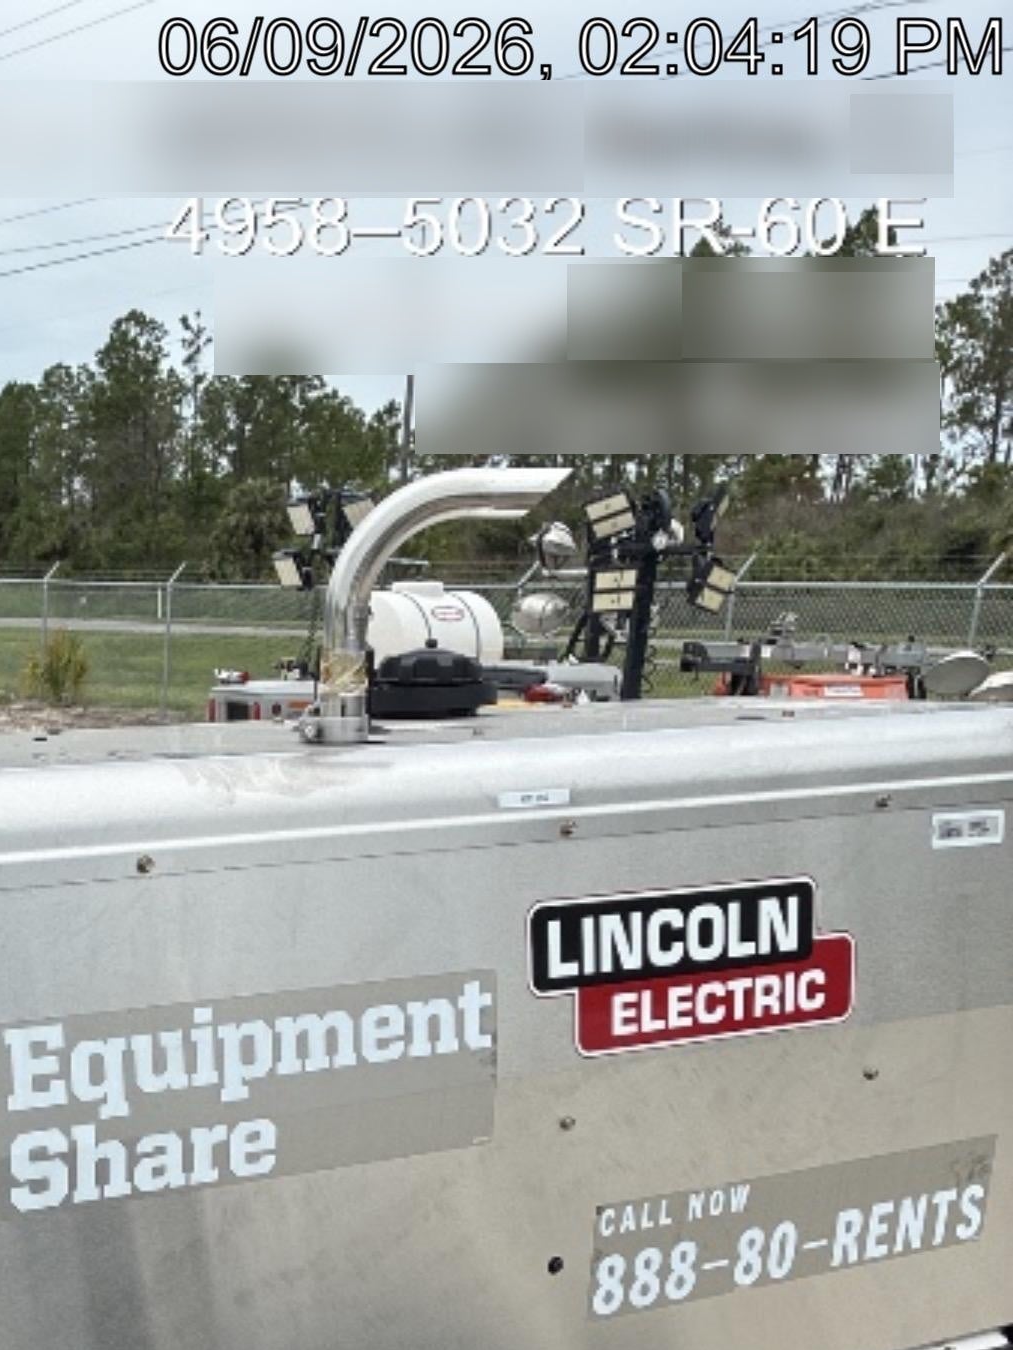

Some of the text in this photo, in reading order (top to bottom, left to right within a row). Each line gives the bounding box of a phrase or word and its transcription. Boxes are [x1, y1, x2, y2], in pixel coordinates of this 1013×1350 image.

[546, 896, 800, 979] LINCOLN
[610, 969, 827, 1036] ELECTRIC
[2, 981, 493, 1119] Equipment
[9, 1117, 278, 1213] Share
[591, 1184, 986, 1316] 888-80-RENTS
[599, 1185, 751, 1238] CALL NOW
